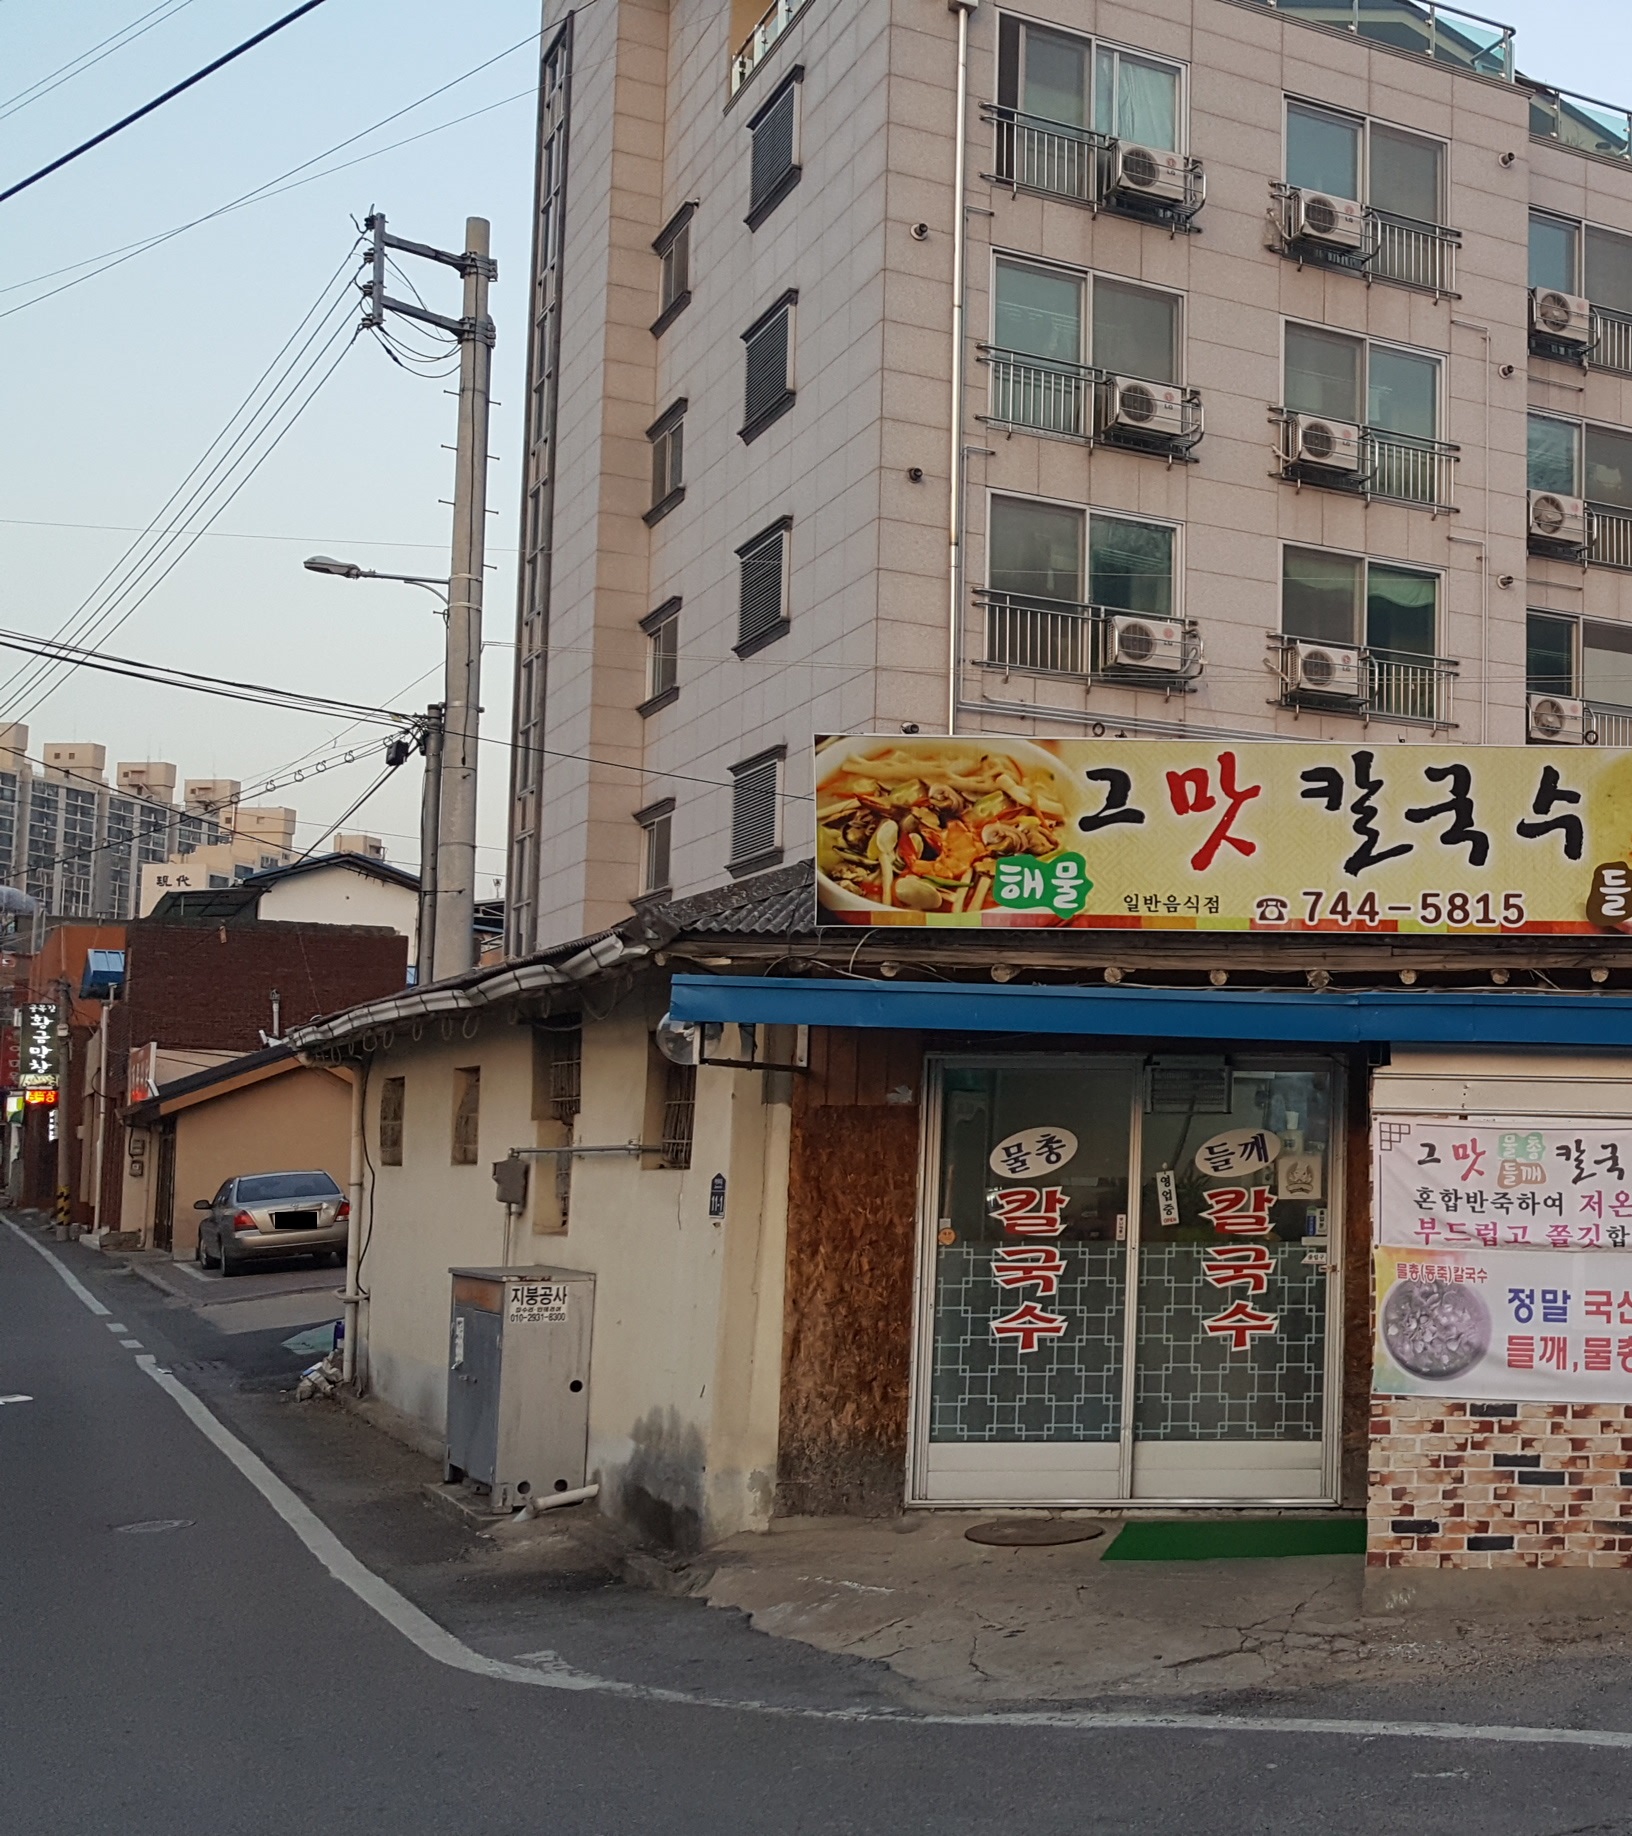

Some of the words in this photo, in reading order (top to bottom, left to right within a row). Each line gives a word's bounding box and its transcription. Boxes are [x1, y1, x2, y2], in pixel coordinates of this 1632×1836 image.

[1300, 750, 1584, 877] 칼국수
[1000, 860, 1085, 910] 해물
[1123, 894, 1221, 914] 일반음식점
[1302, 889, 1526, 926] 744-5815
[29, 1013, 54, 1074] 황금막창
[1000, 1133, 1067, 1175] 물총
[1203, 1132, 1271, 1172] 들깨
[1502, 1162, 1543, 1186] 들깨
[1160, 1174, 1176, 1216] 영업중
[1413, 1186, 1564, 1217] 혼합반죽하여
[1414, 1217, 1532, 1247] 부드럽고
[989, 1185, 1071, 1353] 칼국수
[1199, 1185, 1278, 1352] 칼국수
[511, 1285, 568, 1306] 지붕공사
[1507, 1287, 1572, 1324] 정말
